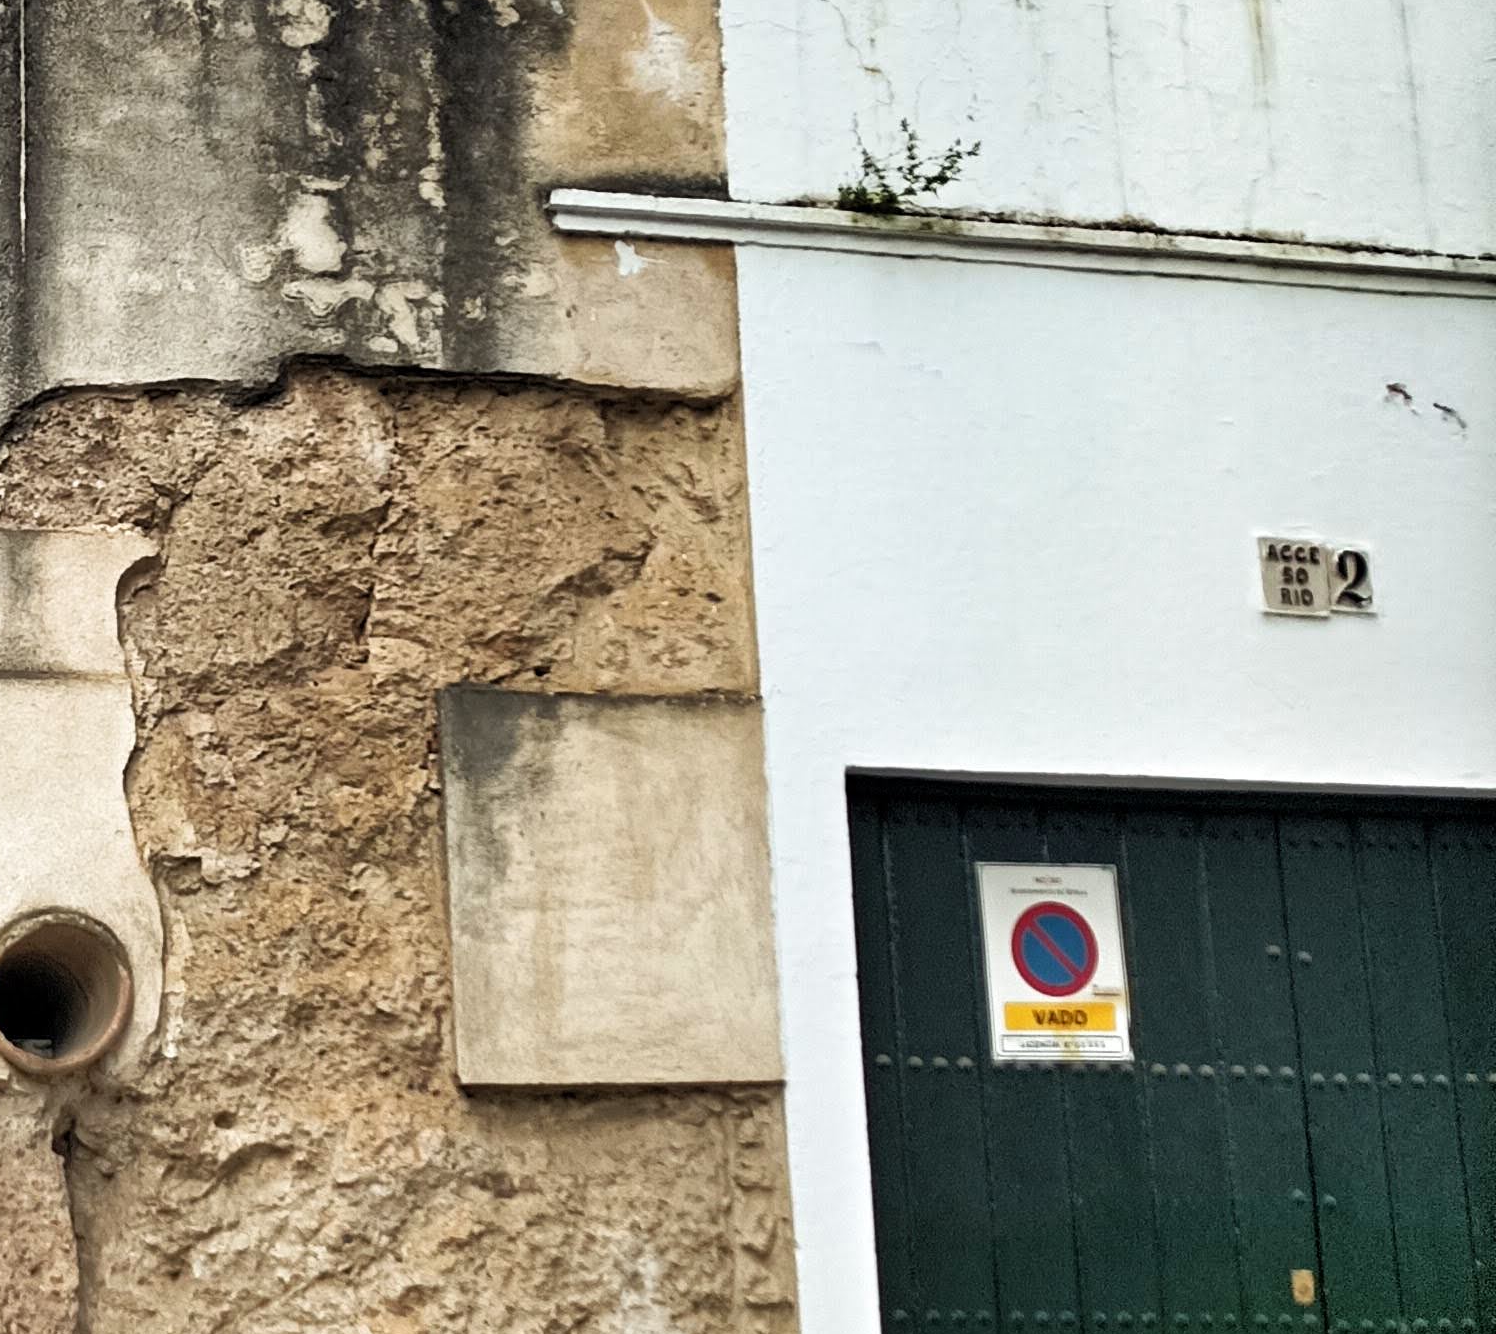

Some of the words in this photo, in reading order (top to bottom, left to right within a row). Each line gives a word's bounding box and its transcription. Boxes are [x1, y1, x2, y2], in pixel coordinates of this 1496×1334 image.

[1266, 544, 1320, 565] ACCE
[1282, 566, 1309, 585] SO
[1336, 550, 1373, 608] 2
[1281, 588, 1313, 606] RIO
[1032, 1009, 1088, 1026] VADO
